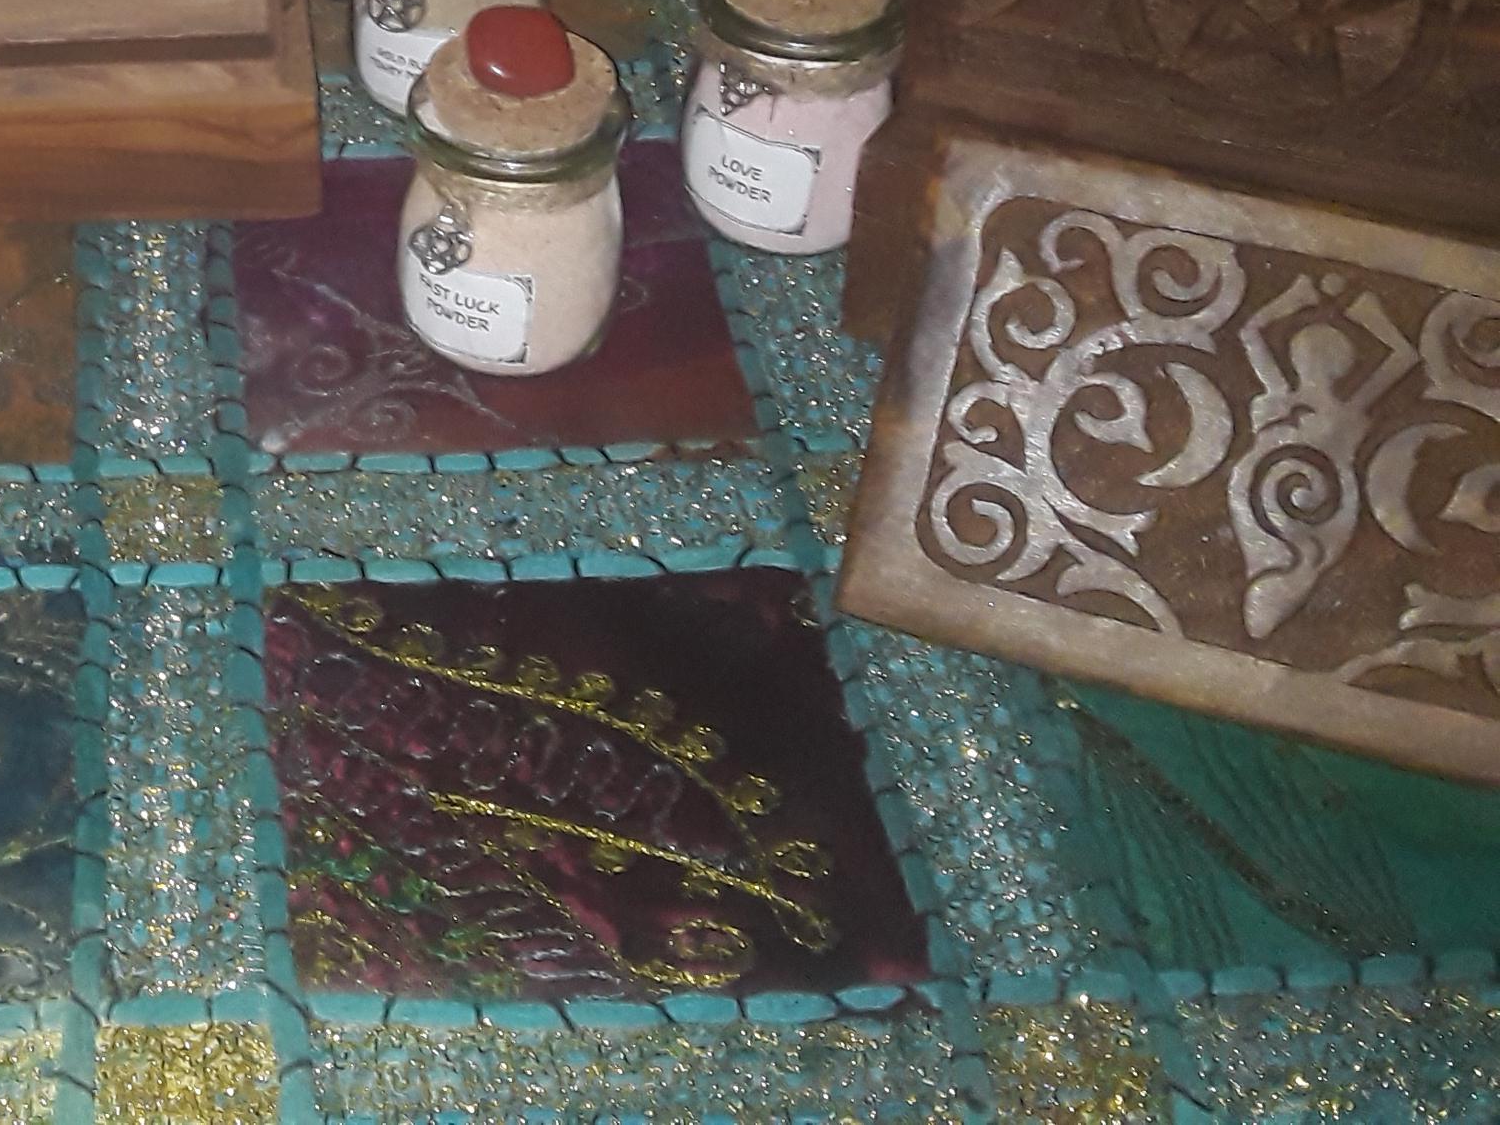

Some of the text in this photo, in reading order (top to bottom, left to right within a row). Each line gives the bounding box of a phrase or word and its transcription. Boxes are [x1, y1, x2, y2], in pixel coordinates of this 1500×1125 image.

[722, 154, 763, 182] LOVE
[708, 165, 772, 204] POWDER
[427, 297, 490, 332] POWDER
[455, 293, 501, 315] LUCK
